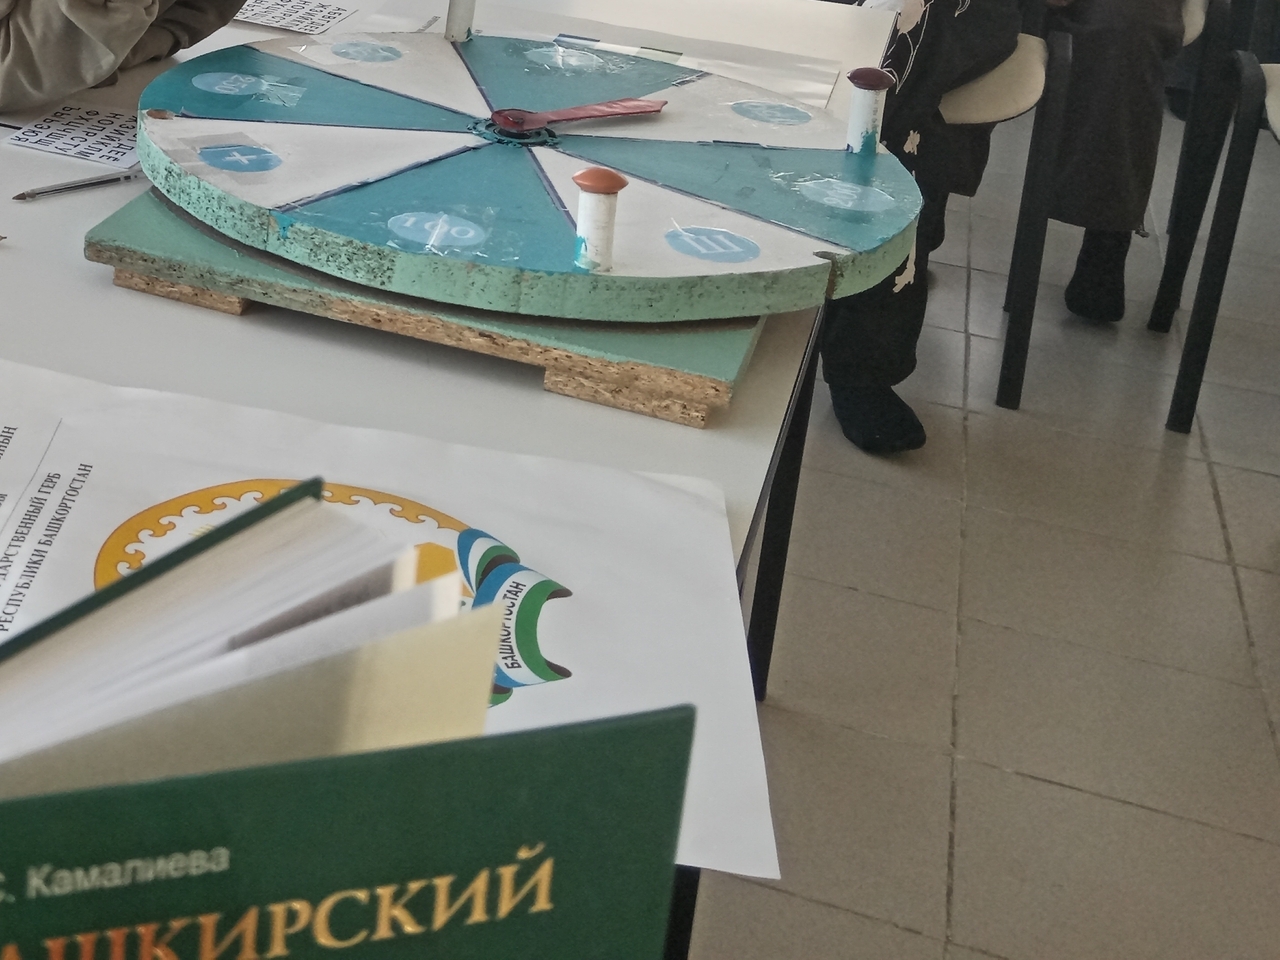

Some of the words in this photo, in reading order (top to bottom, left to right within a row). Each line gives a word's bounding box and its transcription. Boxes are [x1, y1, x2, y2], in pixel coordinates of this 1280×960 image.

[37, 471, 62, 496] ГЕРБ
[38, 462, 93, 547] БАШКОРТОСТАН
[26, 846, 230, 899] Камалиева
